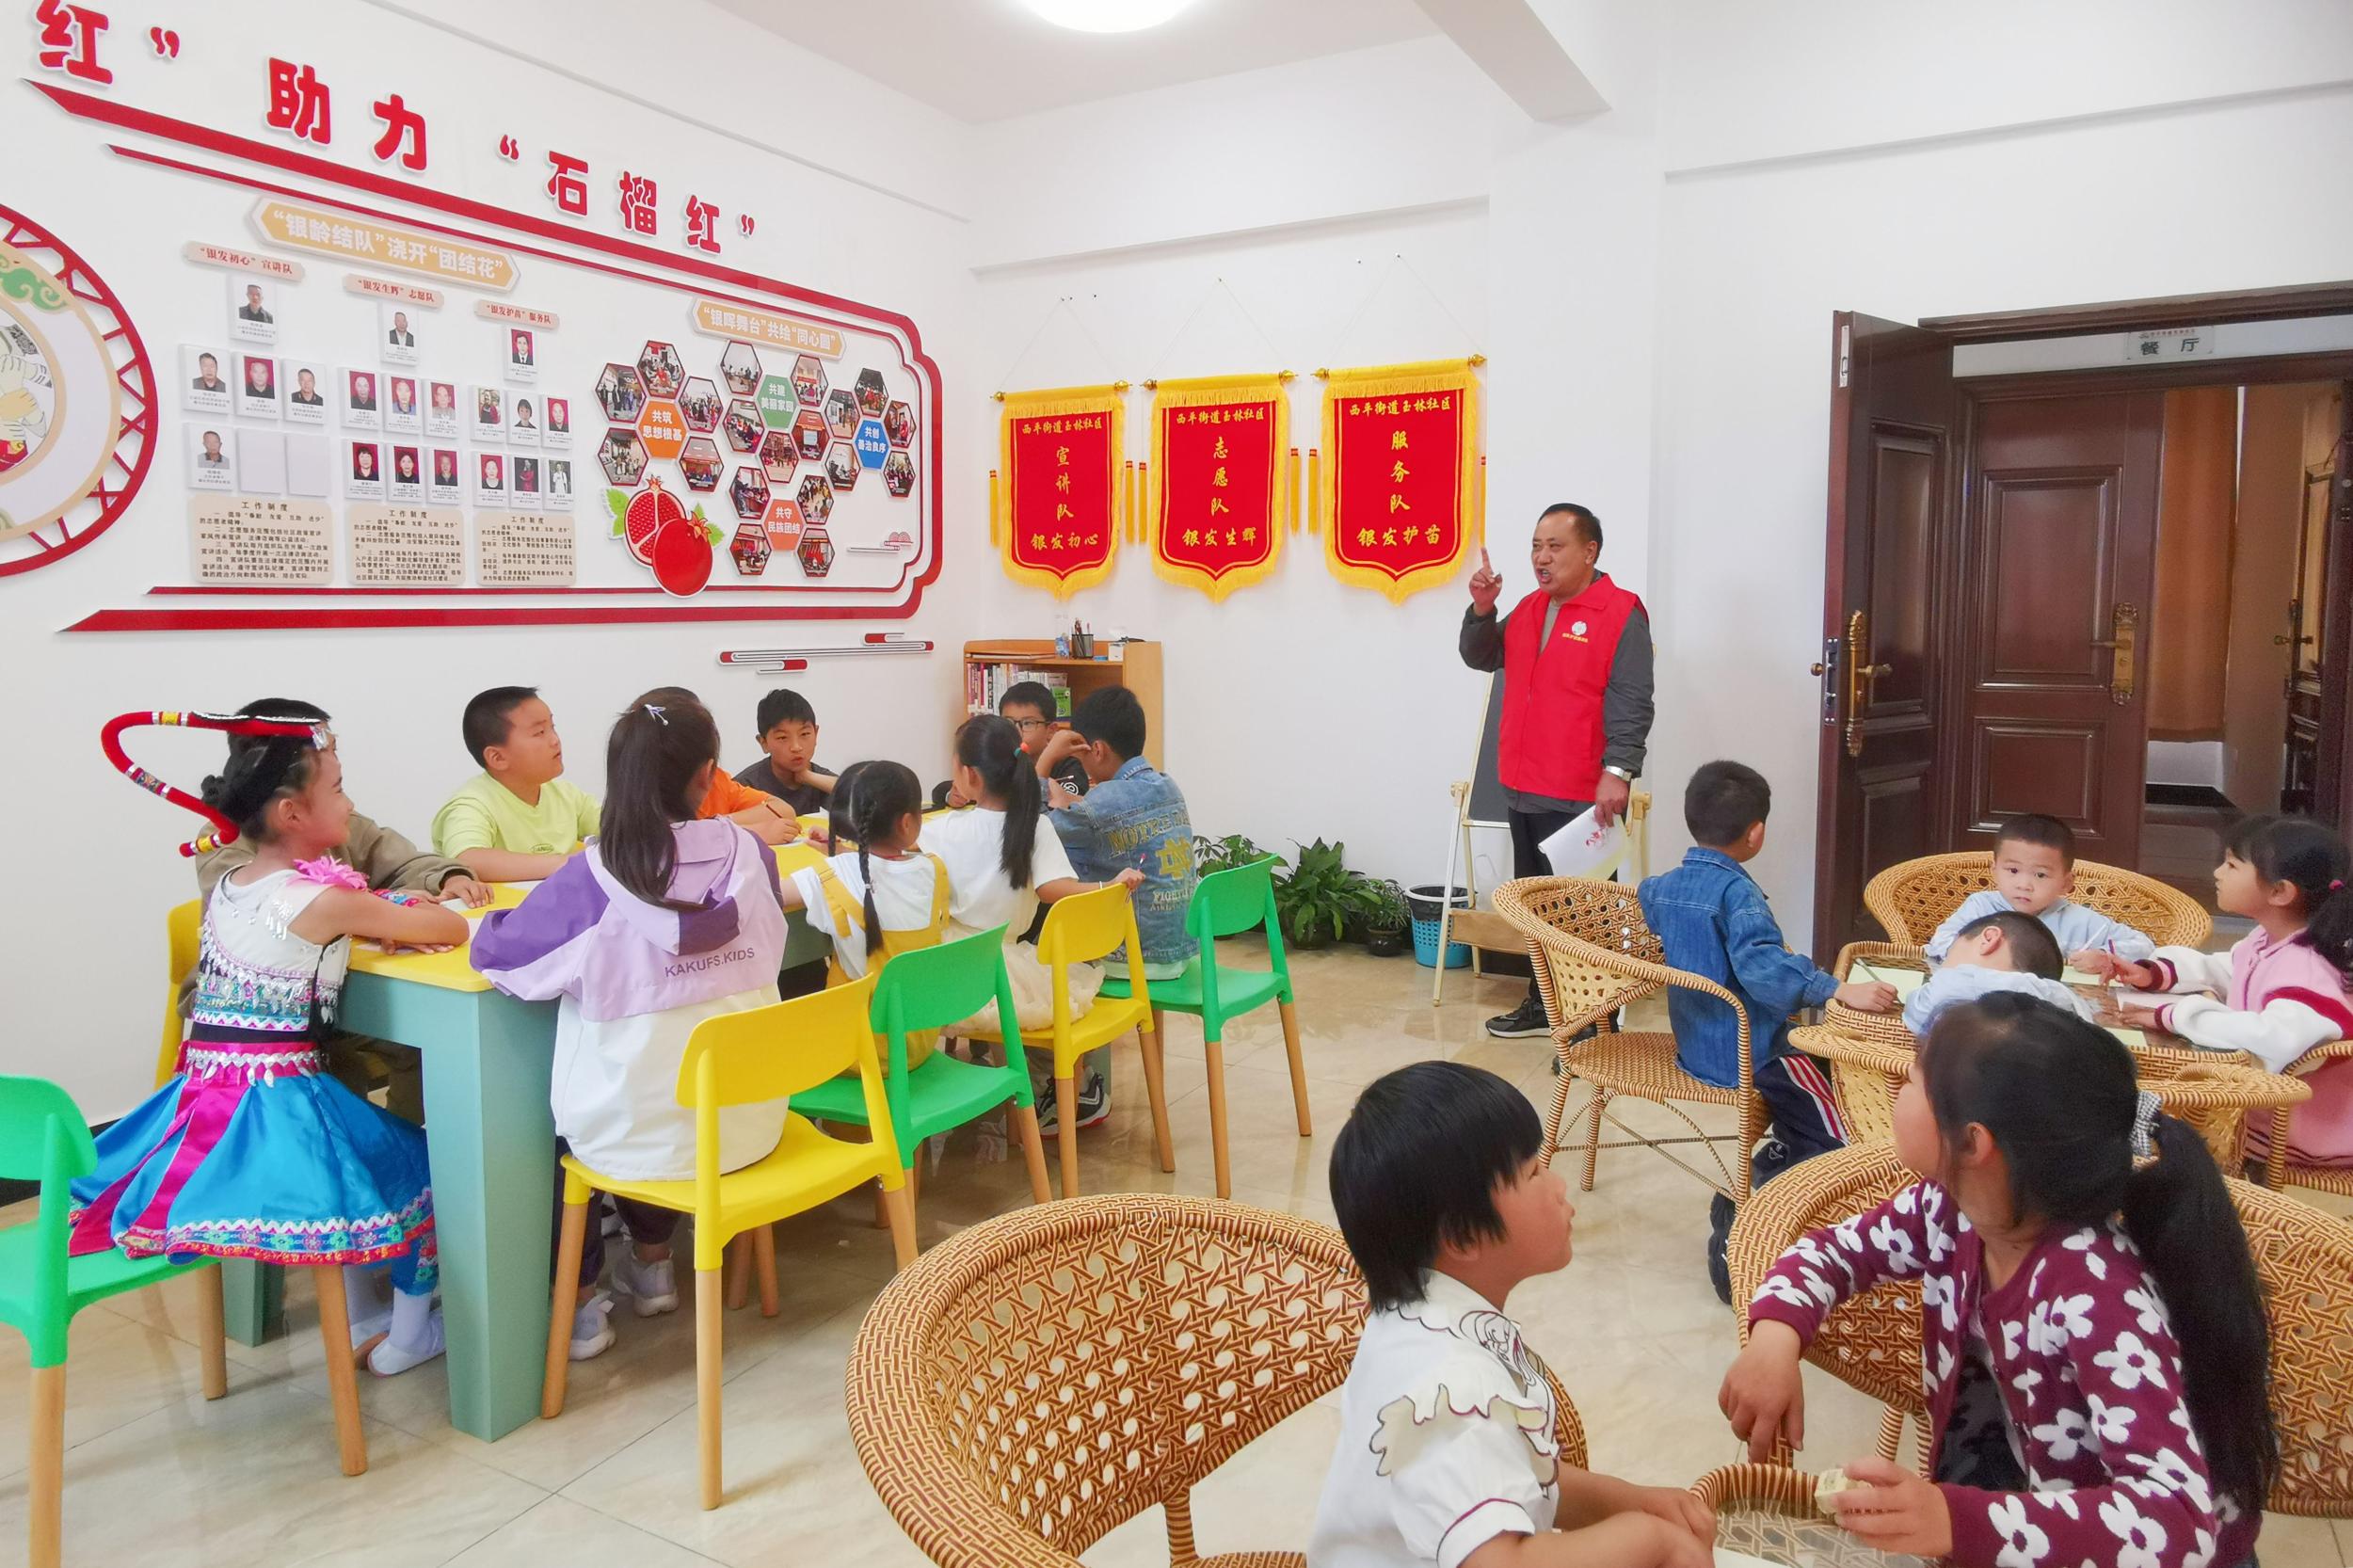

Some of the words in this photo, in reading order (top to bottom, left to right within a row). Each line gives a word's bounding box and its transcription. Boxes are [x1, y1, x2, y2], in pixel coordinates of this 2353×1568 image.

[2140, 338, 2200, 355] 餐厅
[1055, 446, 1074, 520] 宣讲队
[1210, 437, 1229, 516] 志愿队
[1389, 430, 1411, 514] 服务队
[1031, 532, 1098, 551] 银发初心
[1356, 523, 1441, 547] 银发护苗
[664, 947, 755, 978] KAKUFS.KIDS
